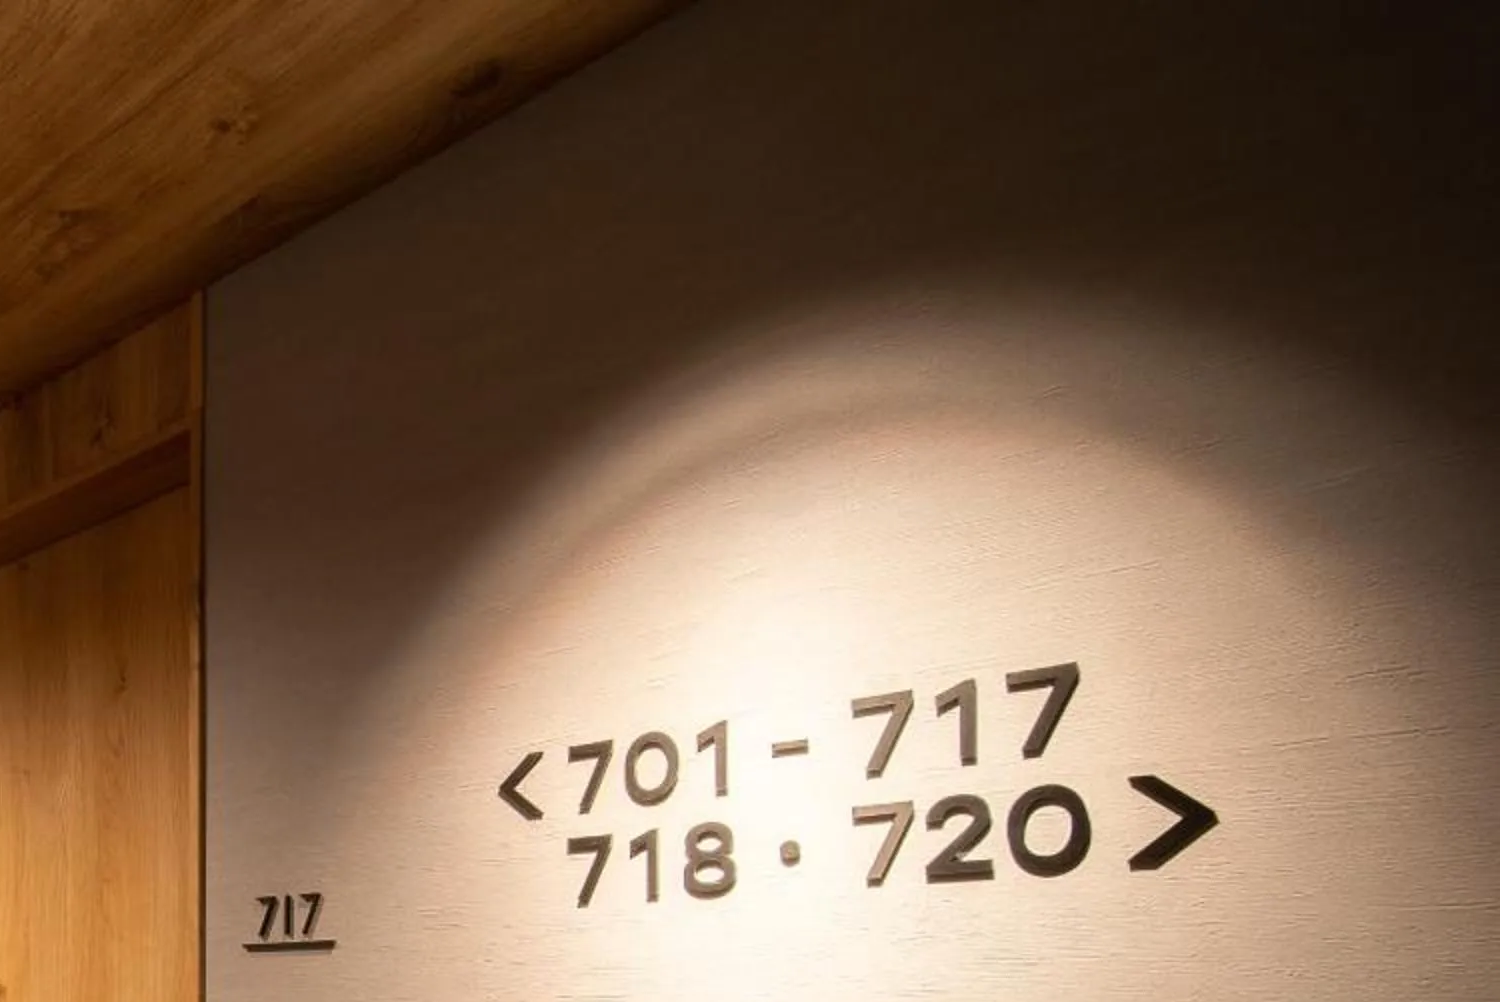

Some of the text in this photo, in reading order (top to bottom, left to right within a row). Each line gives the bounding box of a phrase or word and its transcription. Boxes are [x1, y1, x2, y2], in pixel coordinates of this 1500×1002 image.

[567, 719, 728, 816] 701
[851, 661, 1080, 780] 717
[566, 821, 738, 909] 718
[852, 783, 1092, 888] 720
[255, 892, 323, 941] 717
